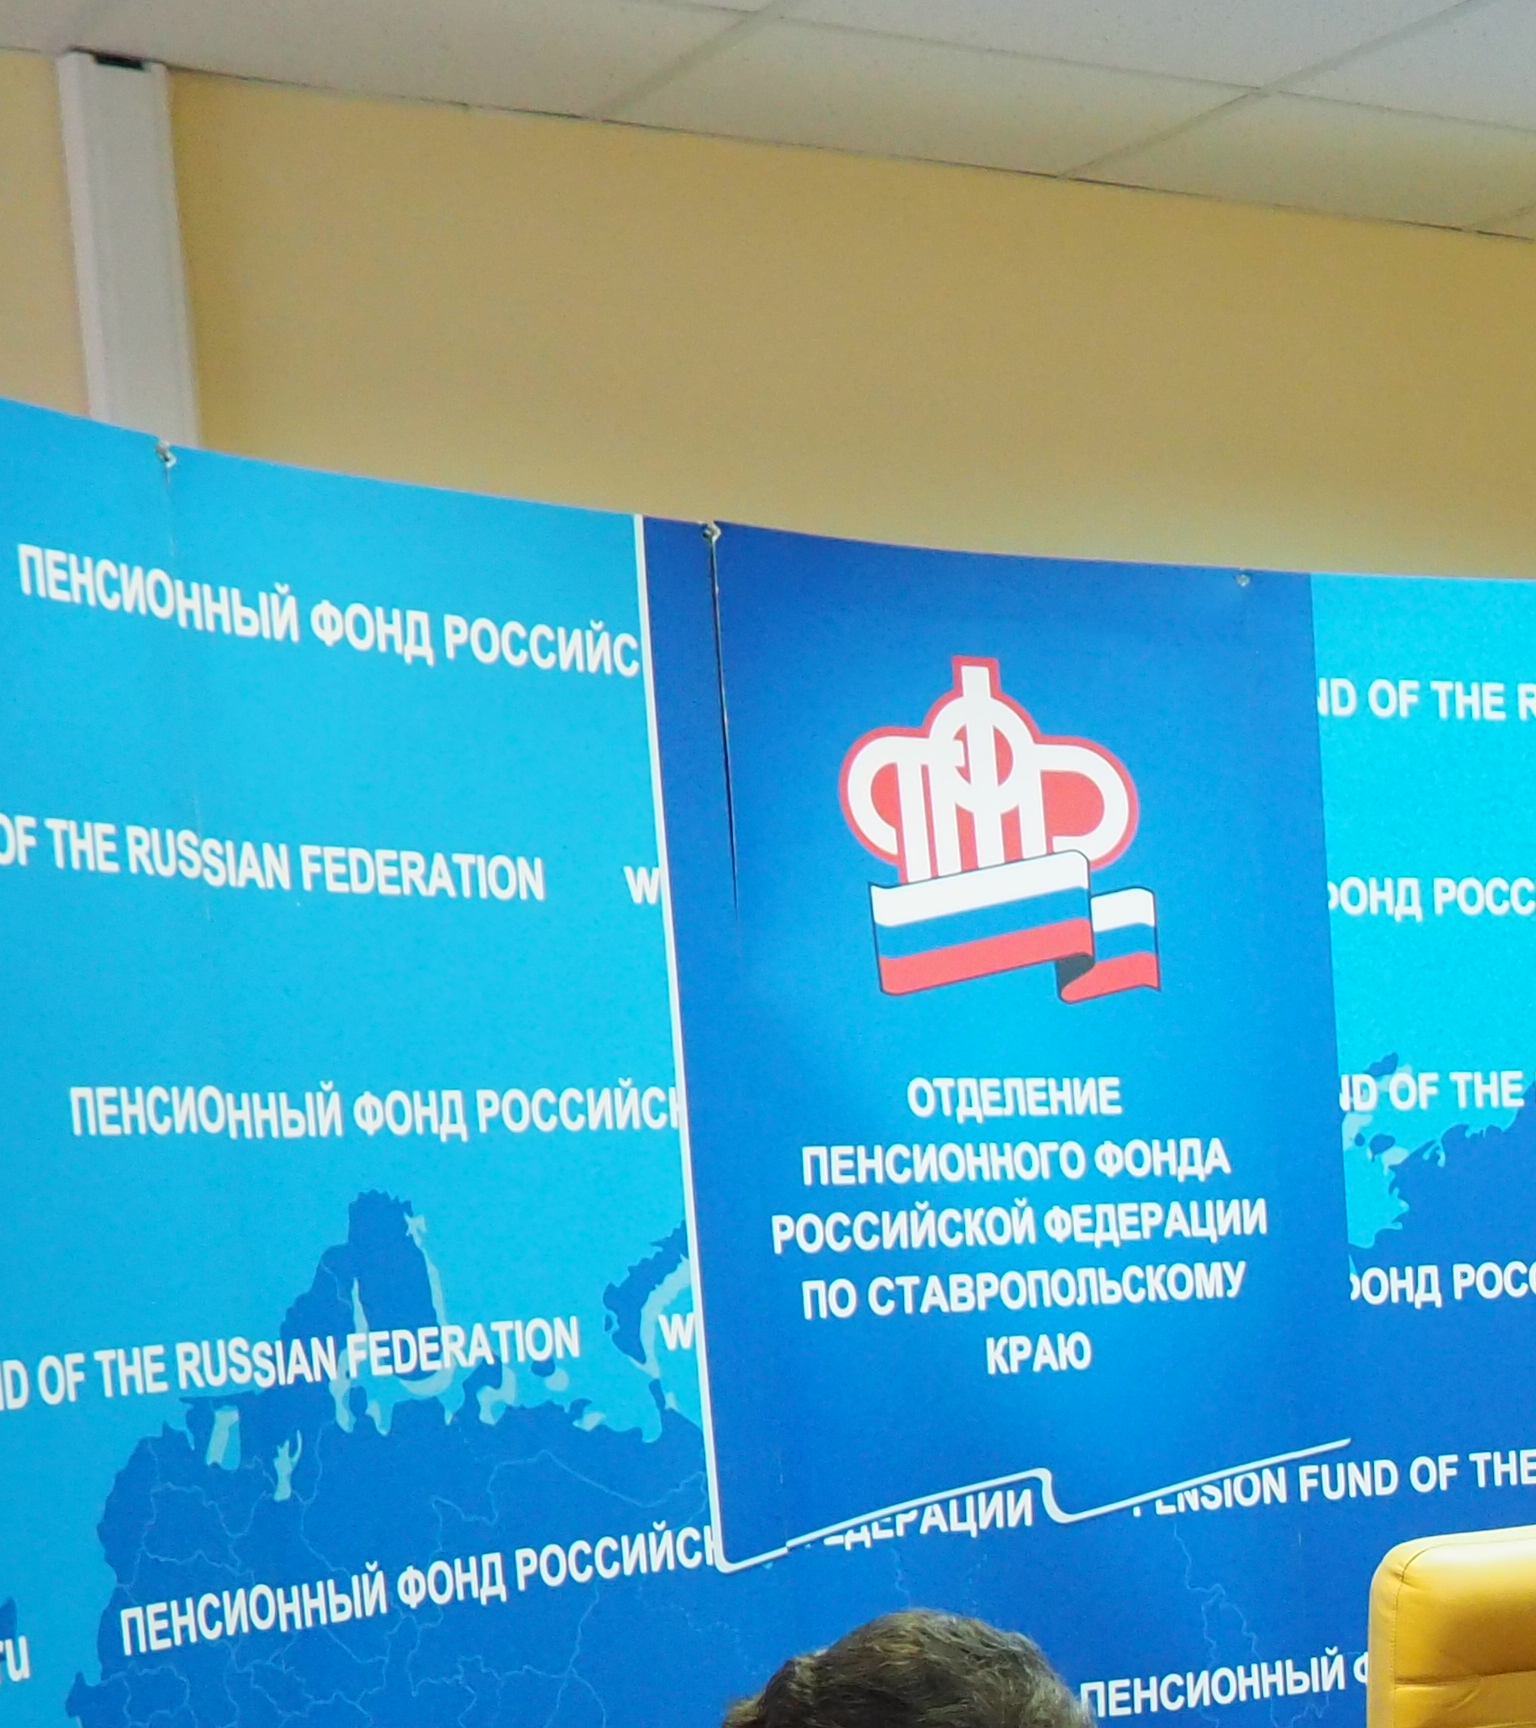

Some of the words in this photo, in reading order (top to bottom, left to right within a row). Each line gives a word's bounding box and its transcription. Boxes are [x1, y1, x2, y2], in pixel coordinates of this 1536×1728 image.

[18, 543, 300, 643] ПЕНСИОННЫЙ
[310, 599, 435, 667] ФОНД
[1368, 679, 1420, 719] OF
[1431, 680, 1508, 722] THE
[45, 818, 120, 874] THE
[127, 825, 291, 890] RUSSIAN
[302, 844, 546, 900] FEDERATION
[70, 1080, 343, 1140] ПЕНСИОННЫЙ
[353, 1089, 469, 1142] ФОНД
[907, 1076, 1122, 1123] ОТДЕЛЕНИЕ
[1389, 1072, 1440, 1111] OF
[1450, 1070, 1523, 1108] THE
[801, 1141, 1086, 1186] ПЕНСИОННОГО
[1095, 1137, 1231, 1182] ФОНДА
[771, 1198, 1036, 1254] РОССИЙСКОЙ
[1044, 1198, 1268, 1248] ФЕДЕРАЦИИ
[802, 1279, 856, 1319] ПО
[868, 1261, 1246, 1317] СТАВРОПОЛЬСКОМУ
[38, 1352, 85, 1406] OF
[94, 1344, 168, 1398] THE
[176, 1335, 340, 1389] RUSSIAN
[346, 1316, 580, 1379] FEDERATION
[986, 1332, 1091, 1374] КРАЮ
[1299, 1459, 1399, 1502] FUND
[1409, 1453, 1458, 1494] OF
[120, 1561, 388, 1656] ПЕНСИОННЫЙ
[397, 1552, 506, 1610] ФОНД
[1080, 1646, 1346, 1717] ПЕНСИОННЫЙ
